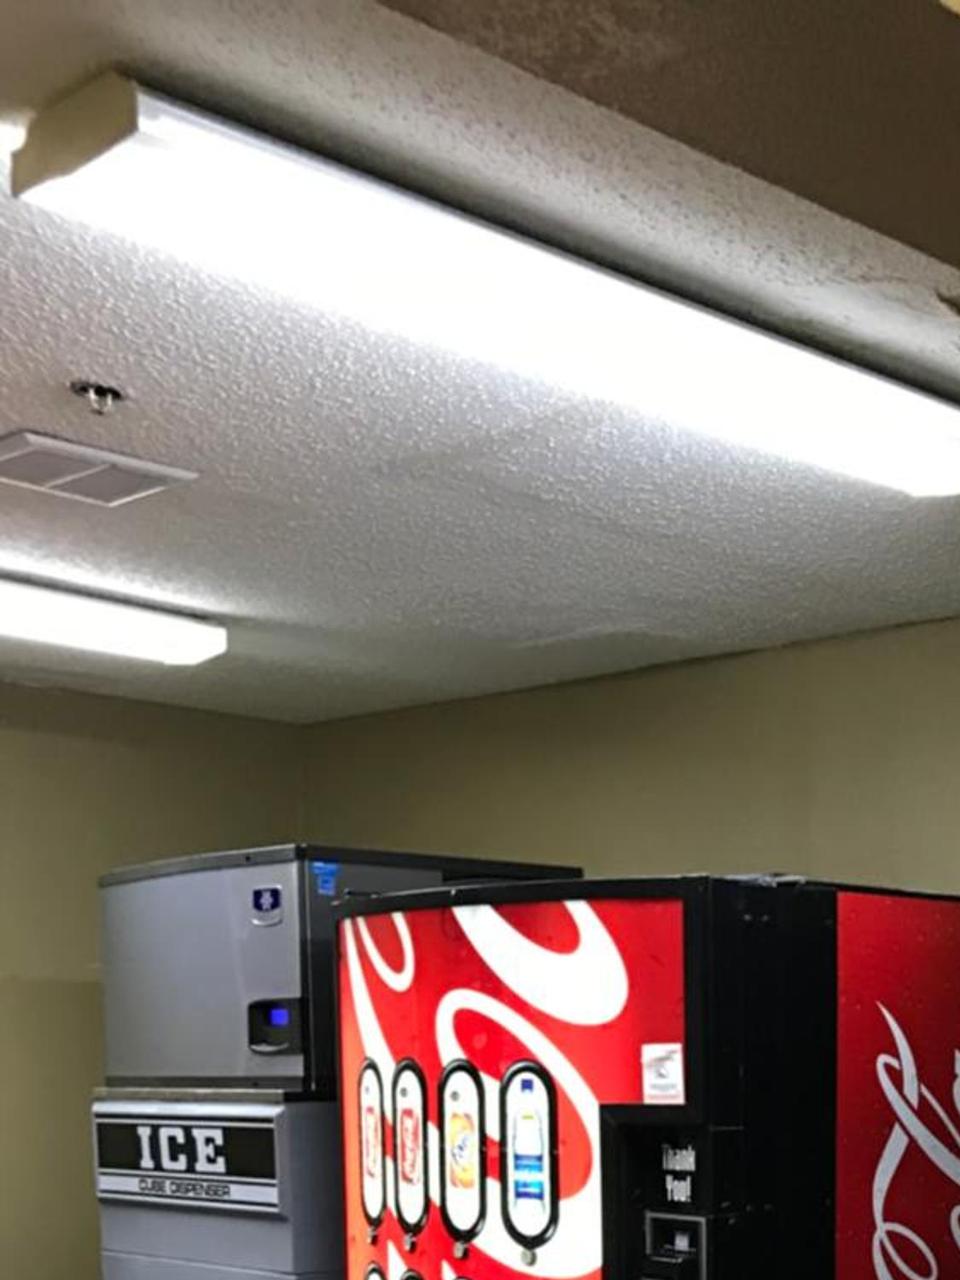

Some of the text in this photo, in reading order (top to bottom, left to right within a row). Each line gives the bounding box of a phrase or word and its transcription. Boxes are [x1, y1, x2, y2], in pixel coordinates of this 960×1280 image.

[136, 1126, 227, 1174] ICE
[662, 1144, 696, 1171] Thank
[138, 1178, 231, 1198] CUBE DISPENSER
